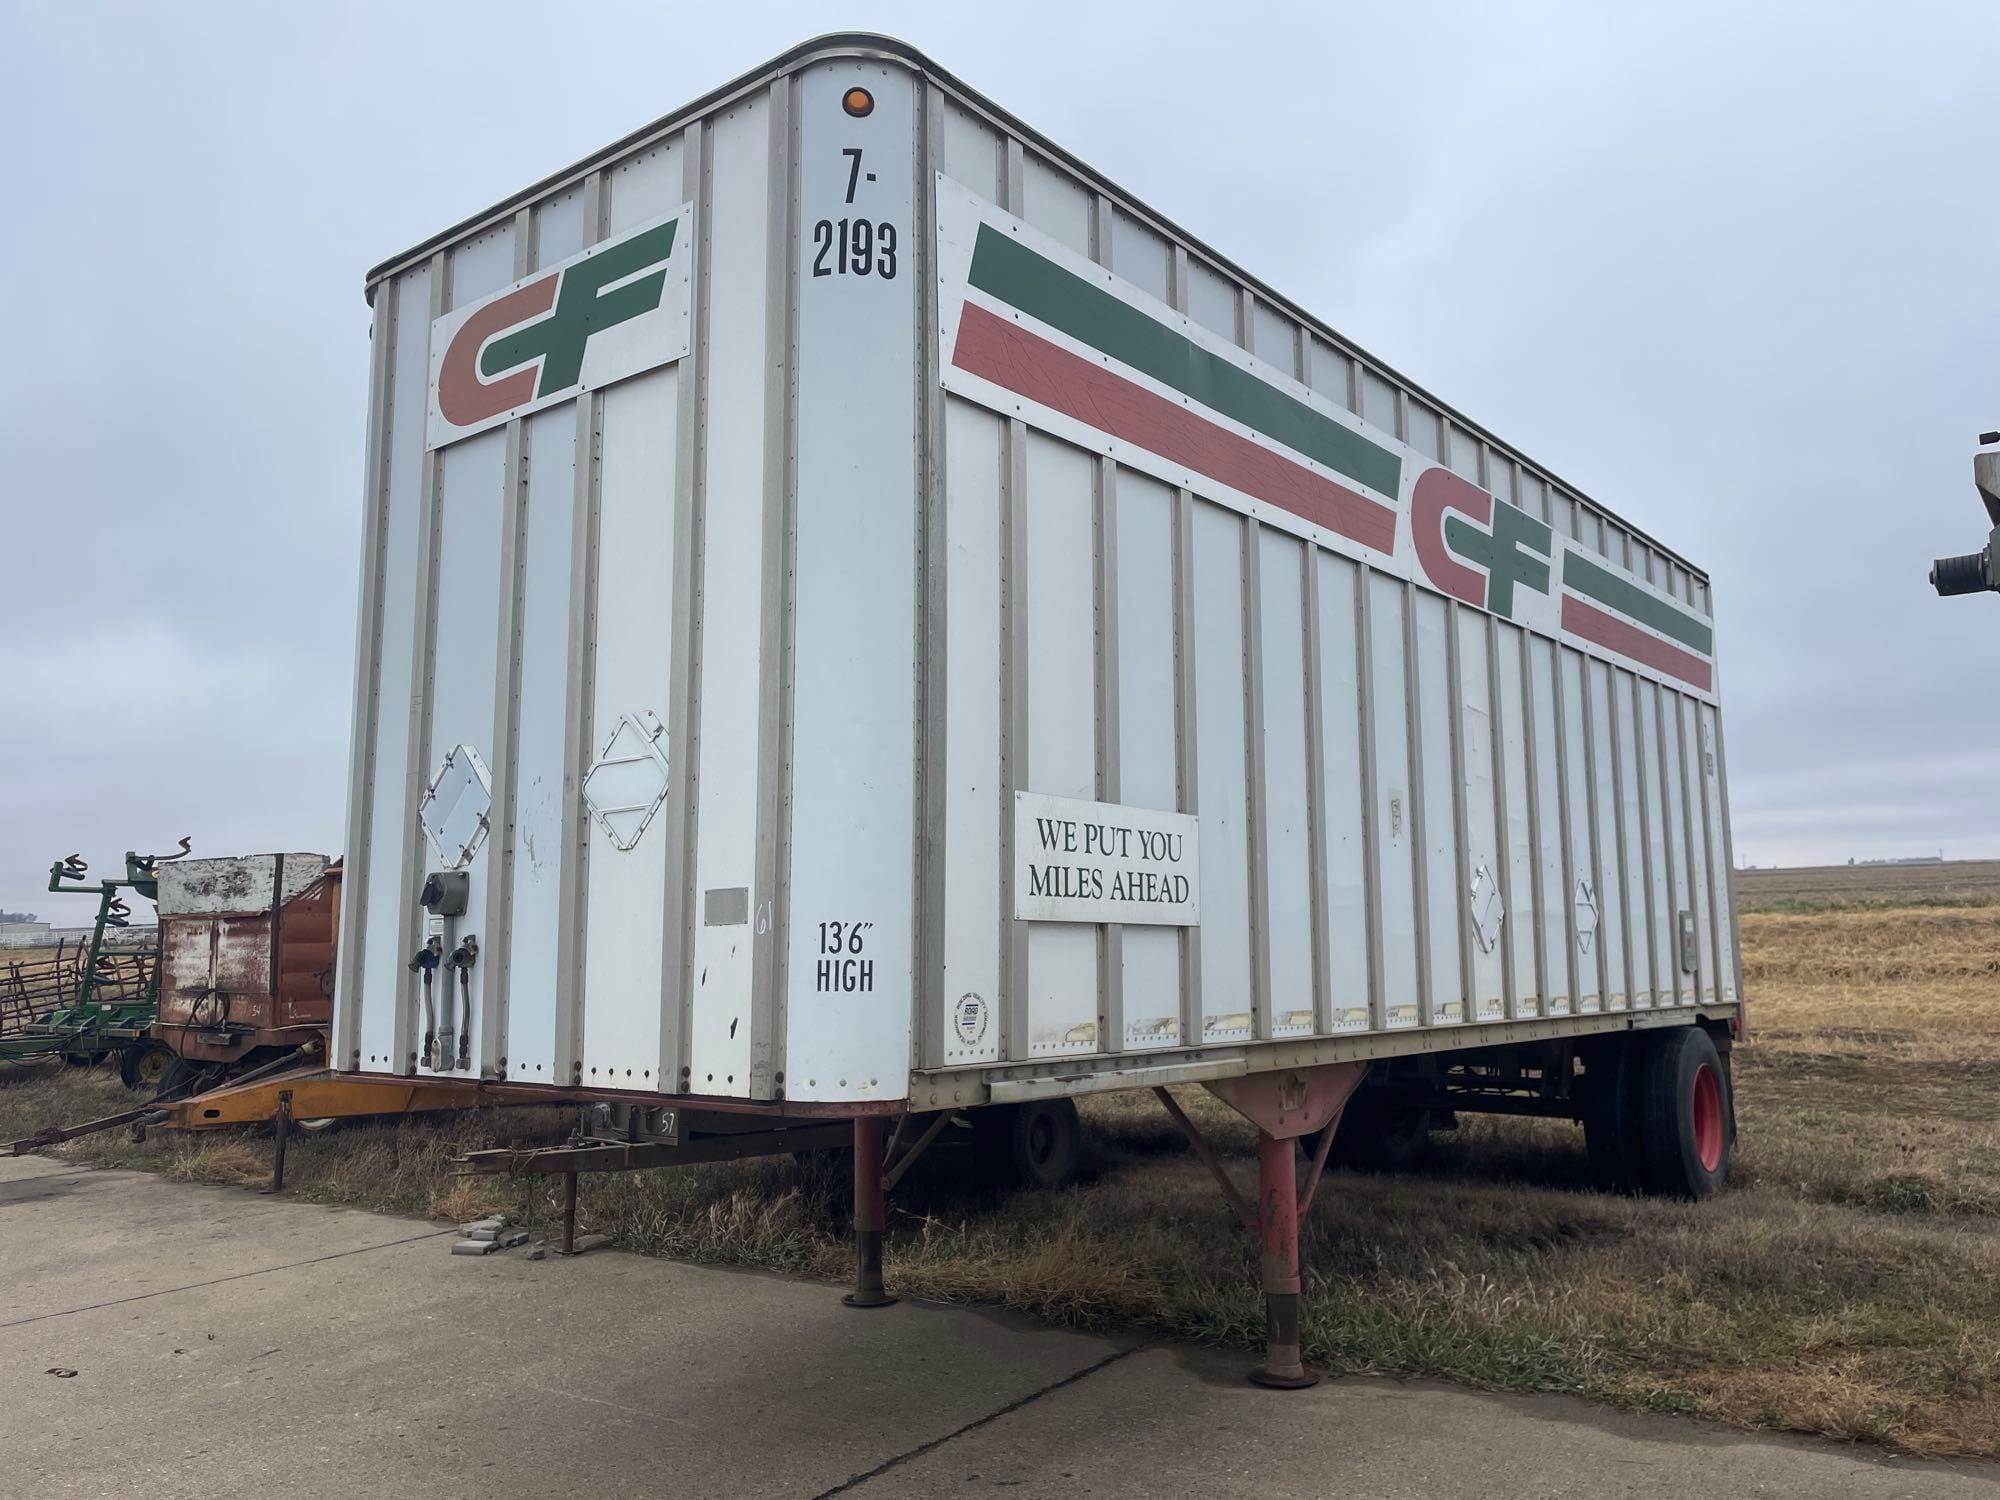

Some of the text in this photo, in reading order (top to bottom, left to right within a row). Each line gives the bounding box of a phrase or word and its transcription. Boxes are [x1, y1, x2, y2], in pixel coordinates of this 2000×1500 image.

[842, 148, 877, 204] 7-
[813, 218, 897, 280] 2193
[438, 217, 679, 427] CF
[1411, 467, 1552, 620] CF
[1036, 818, 1182, 863] WE PUT YOU
[1029, 864, 1190, 904] MILES AHEAD
[756, 900, 772, 935] 61
[817, 959, 873, 992] HIGH
